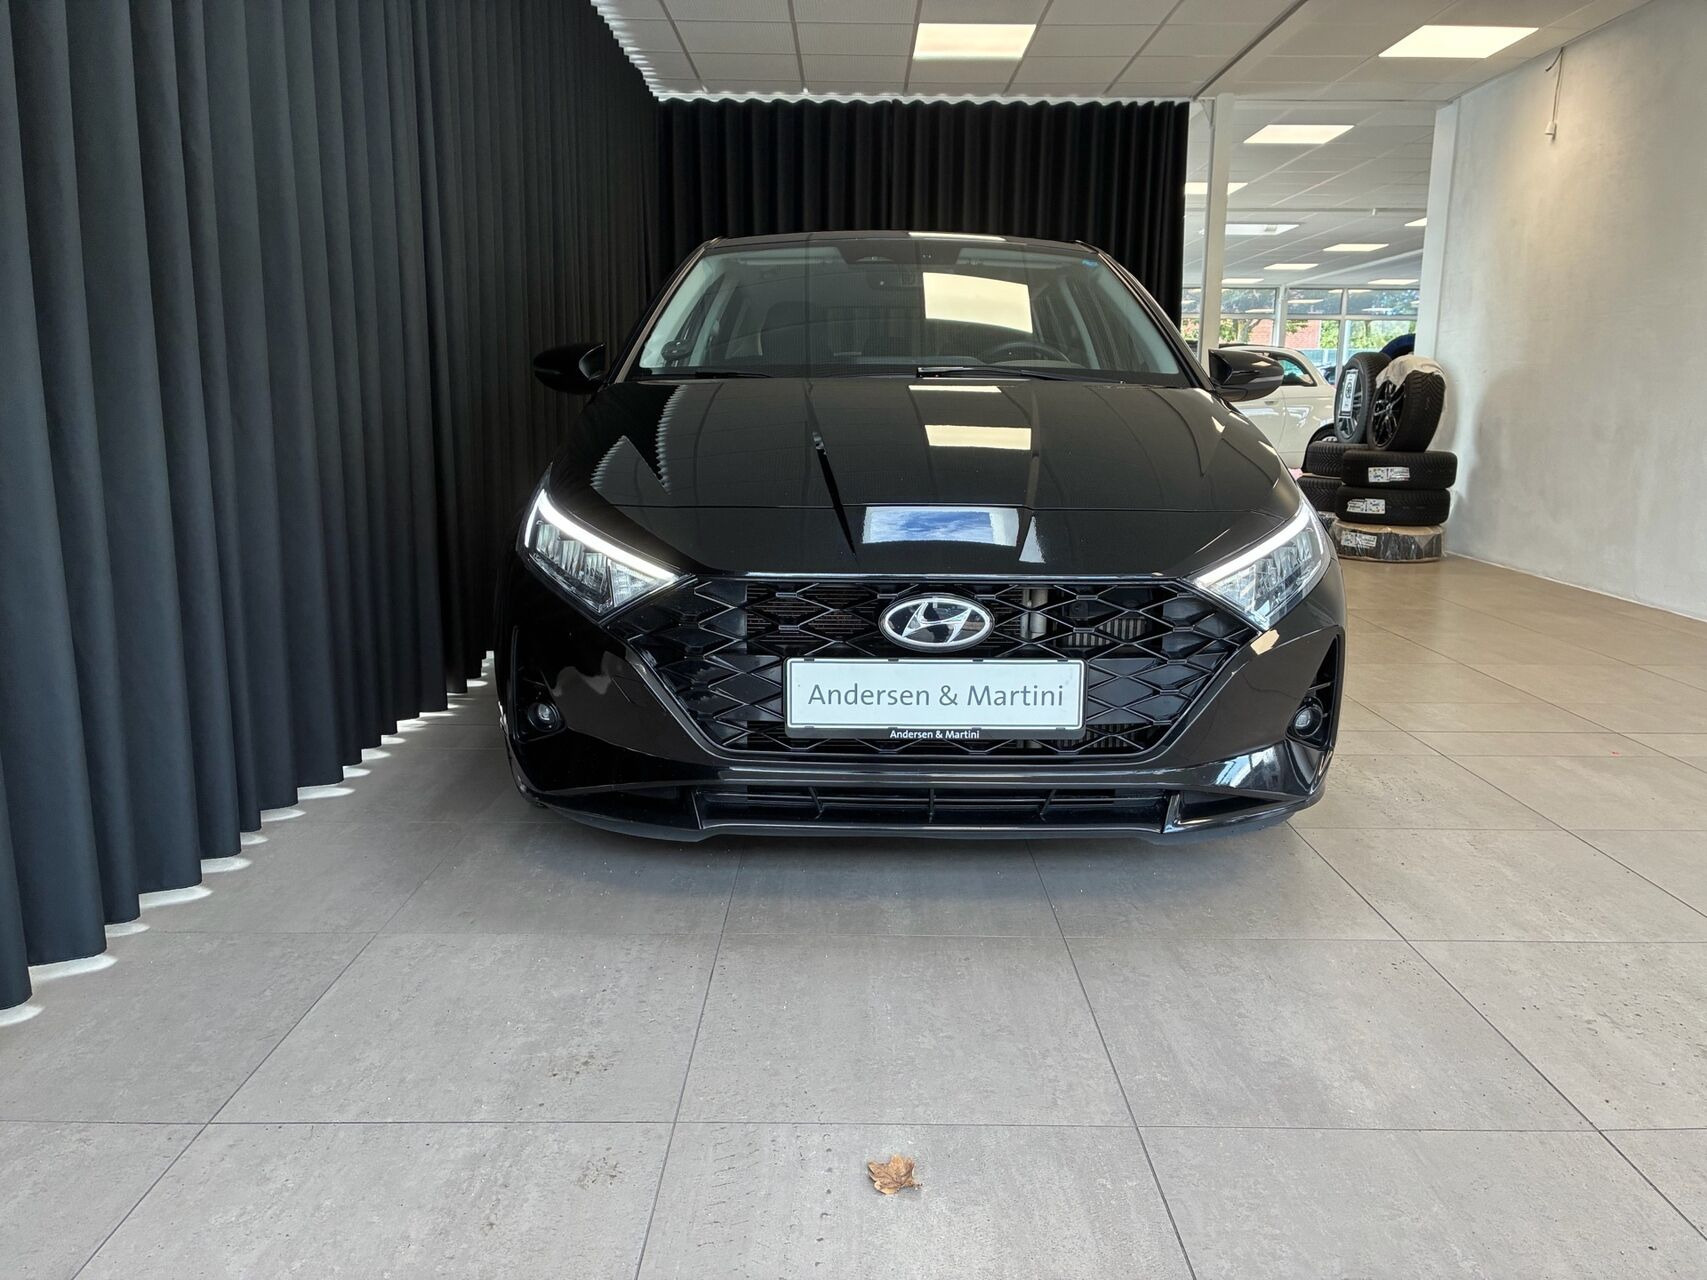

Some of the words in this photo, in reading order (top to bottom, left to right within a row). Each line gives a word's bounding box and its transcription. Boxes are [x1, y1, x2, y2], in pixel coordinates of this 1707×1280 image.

[808, 683, 930, 705] Andersen
[939, 685, 958, 705] &
[967, 685, 1063, 706] Martini
[890, 729, 933, 739] Andersen
[935, 729, 943, 739] &
[945, 729, 980, 739] Martini
